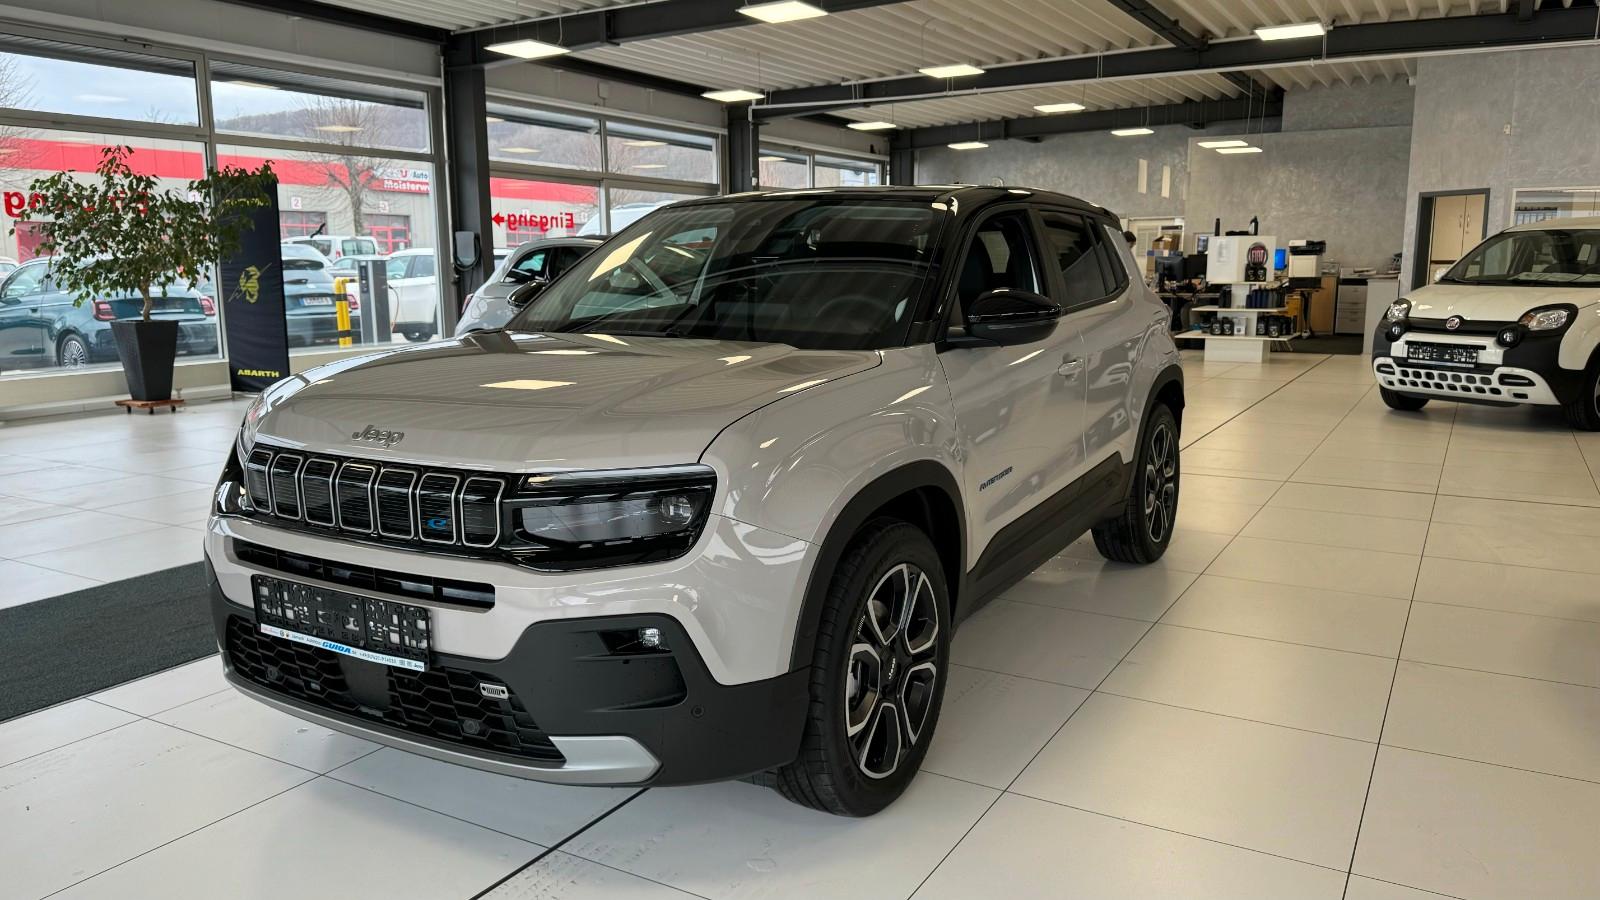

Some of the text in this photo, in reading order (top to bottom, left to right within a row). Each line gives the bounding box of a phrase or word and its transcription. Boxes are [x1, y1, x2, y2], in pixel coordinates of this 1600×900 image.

[1251, 249, 1265, 264] FIAT
[237, 369, 280, 378] ABARTH
[351, 424, 405, 449] Jeep
[322, 641, 352, 654] GUIDA
